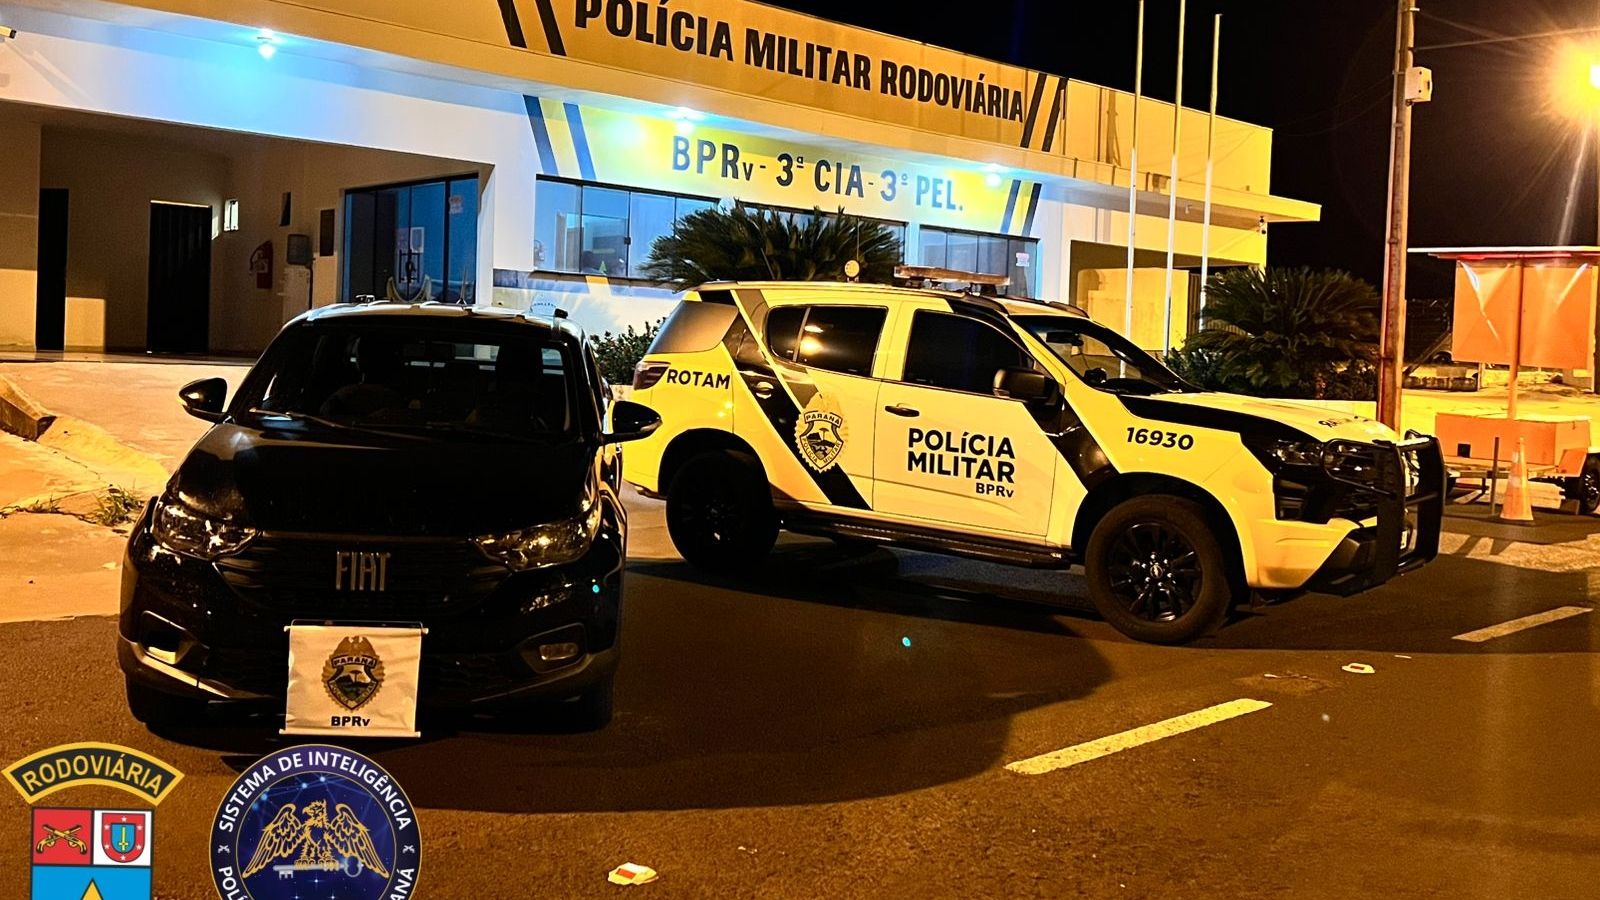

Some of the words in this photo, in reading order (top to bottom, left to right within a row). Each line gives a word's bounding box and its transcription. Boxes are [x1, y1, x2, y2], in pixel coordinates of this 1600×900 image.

[575, 0, 734, 62] POLÍCIA
[745, 28, 871, 91] MILITAR
[880, 59, 1024, 123] RODOVIÁRIA
[814, 159, 865, 198] CIA
[915, 175, 964, 212] PEL.
[667, 369, 731, 390] ROTAM
[1127, 427, 1194, 451] 16930
[907, 451, 1015, 484] MILITAR
[975, 482, 1014, 498] BPRv
[335, 551, 392, 592] FIAT
[331, 716, 371, 727] BPRv
